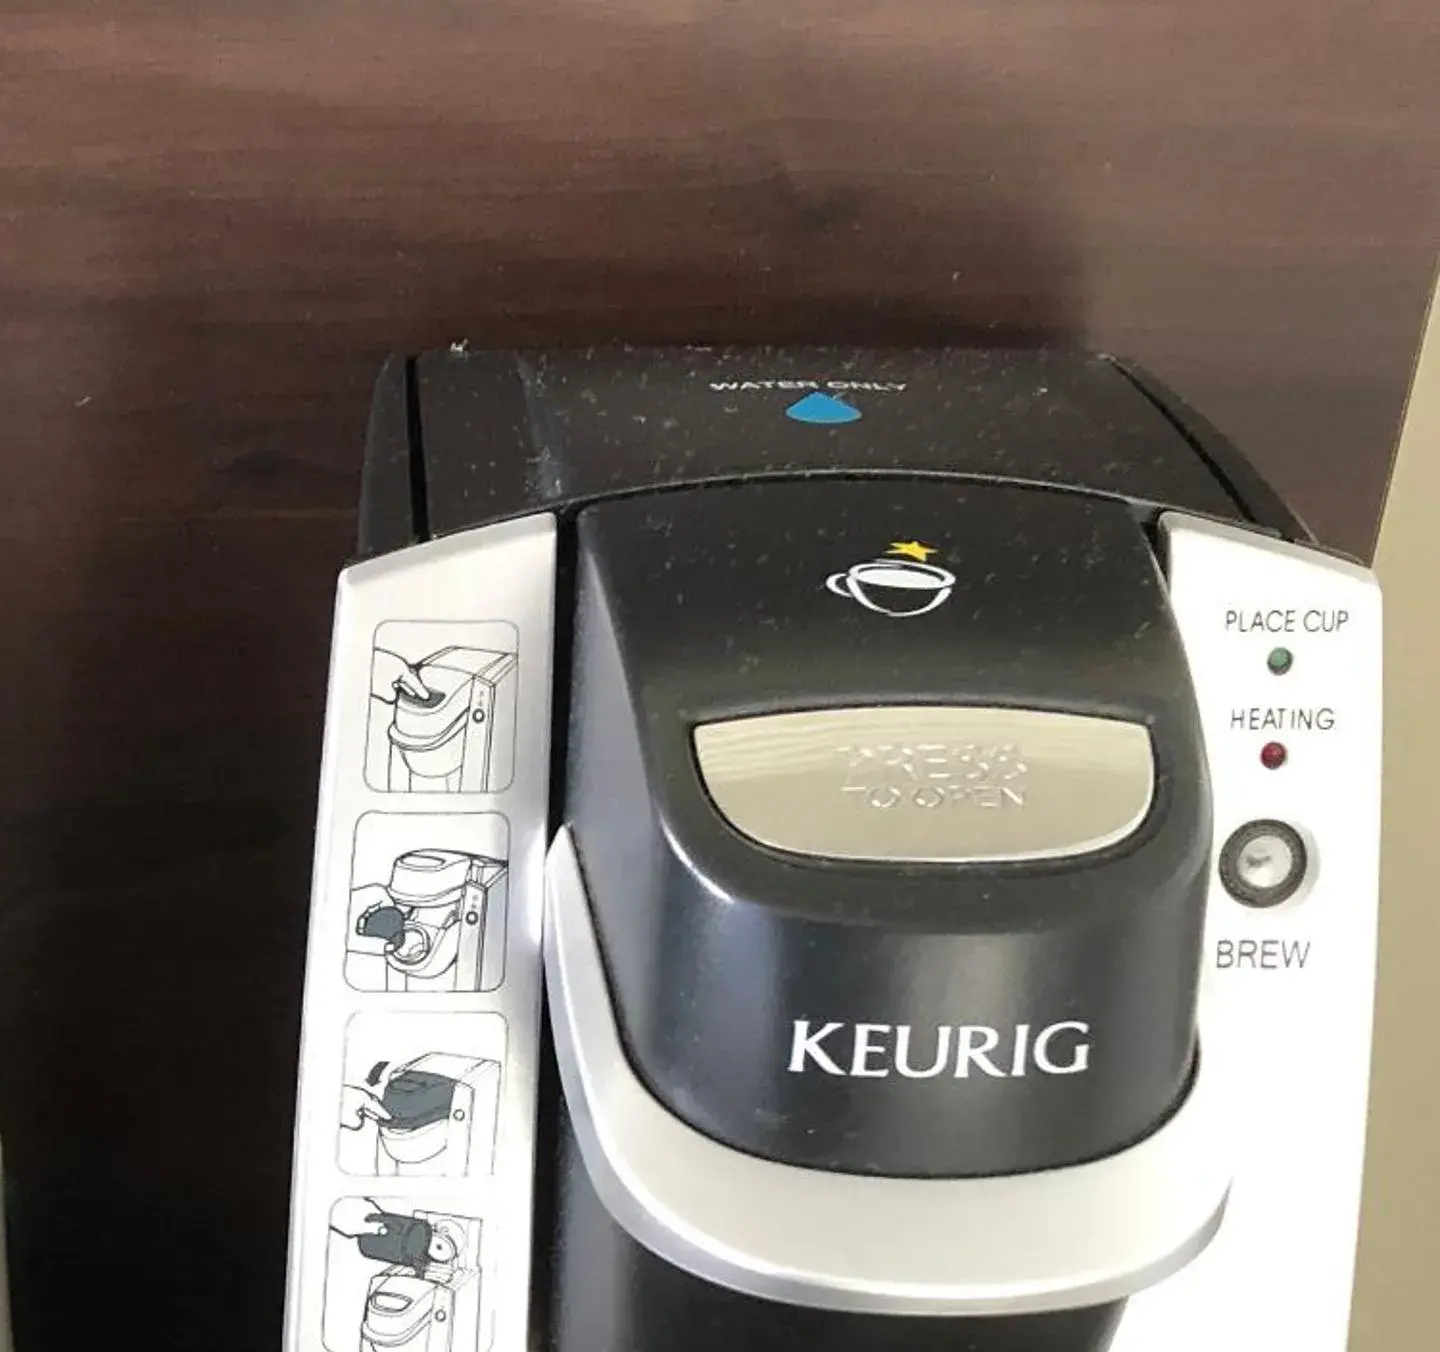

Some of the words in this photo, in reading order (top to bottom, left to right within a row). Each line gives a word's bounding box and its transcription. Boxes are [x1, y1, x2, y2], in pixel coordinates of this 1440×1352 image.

[709, 380, 819, 391] WATER
[826, 380, 907, 391] ONLY
[1225, 609, 1296, 632] PLACE
[1303, 609, 1349, 632] CUP
[1230, 707, 1335, 730] HEATING
[836, 744, 1027, 780] PRESS
[841, 785, 901, 809] TO
[911, 785, 1026, 809] OPEN
[1216, 939, 1311, 969] BREW
[787, 1020, 1091, 1078] KEURIG
